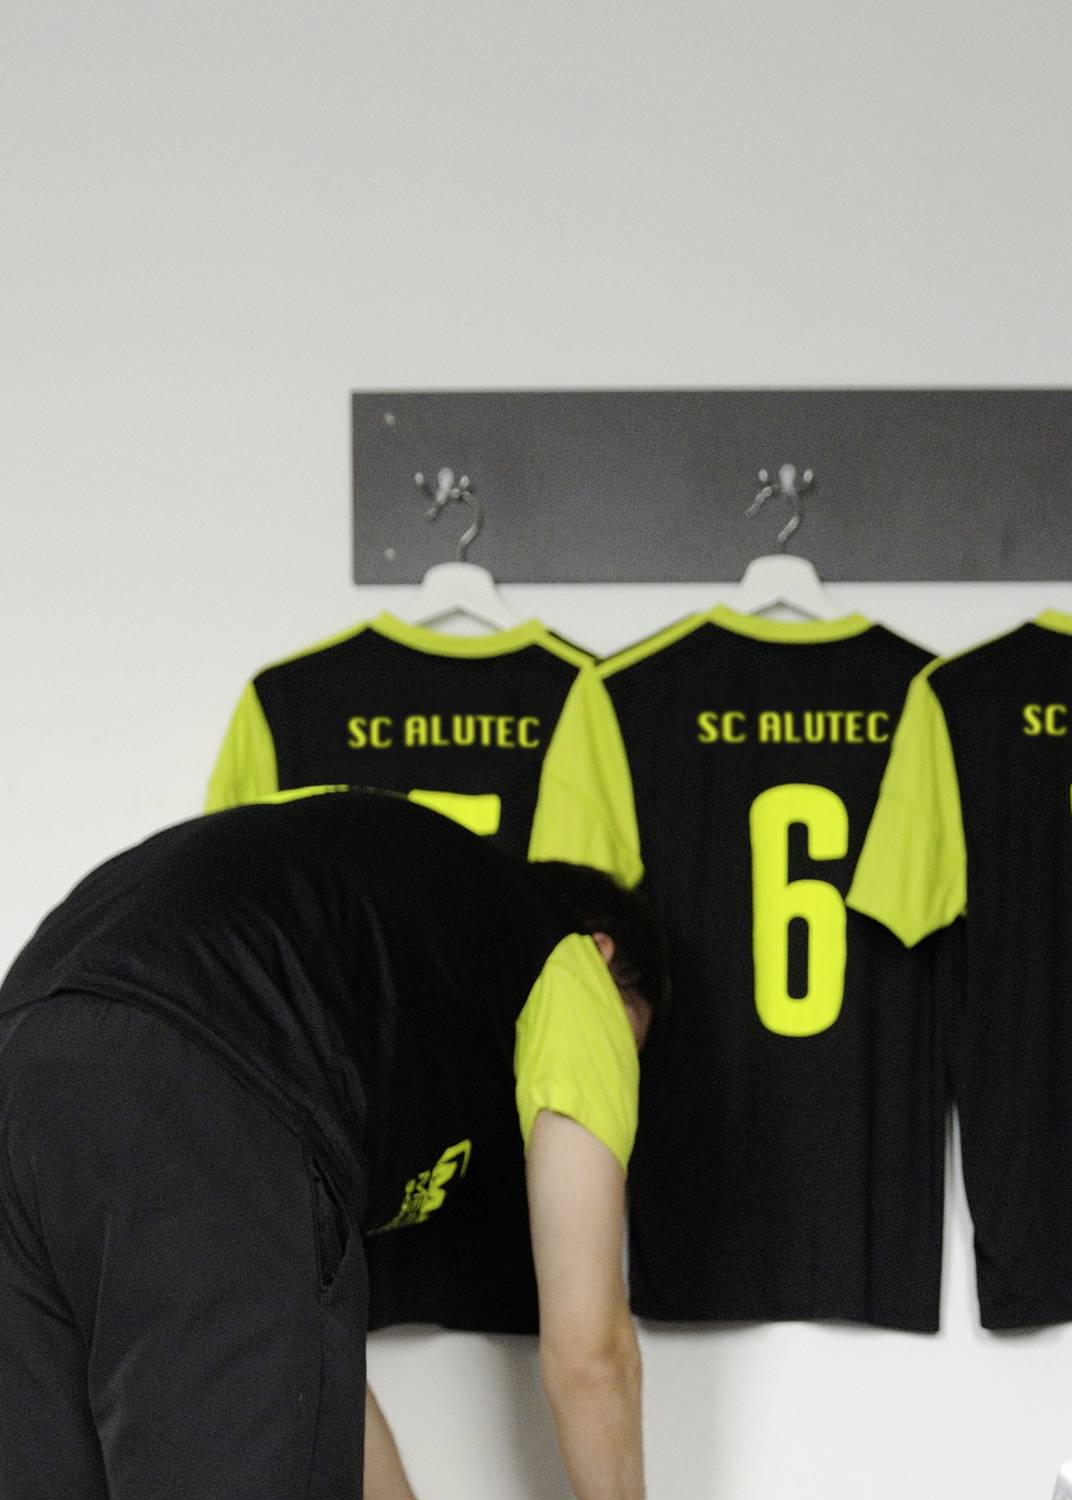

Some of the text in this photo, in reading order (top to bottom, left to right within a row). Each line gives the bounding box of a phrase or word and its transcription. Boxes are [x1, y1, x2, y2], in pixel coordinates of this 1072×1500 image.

[347, 714, 540, 749] SC ALUTEC
[697, 709, 890, 744] SC ALUTEC
[1022, 703, 1066, 738] SC
[749, 782, 849, 1038] 6
